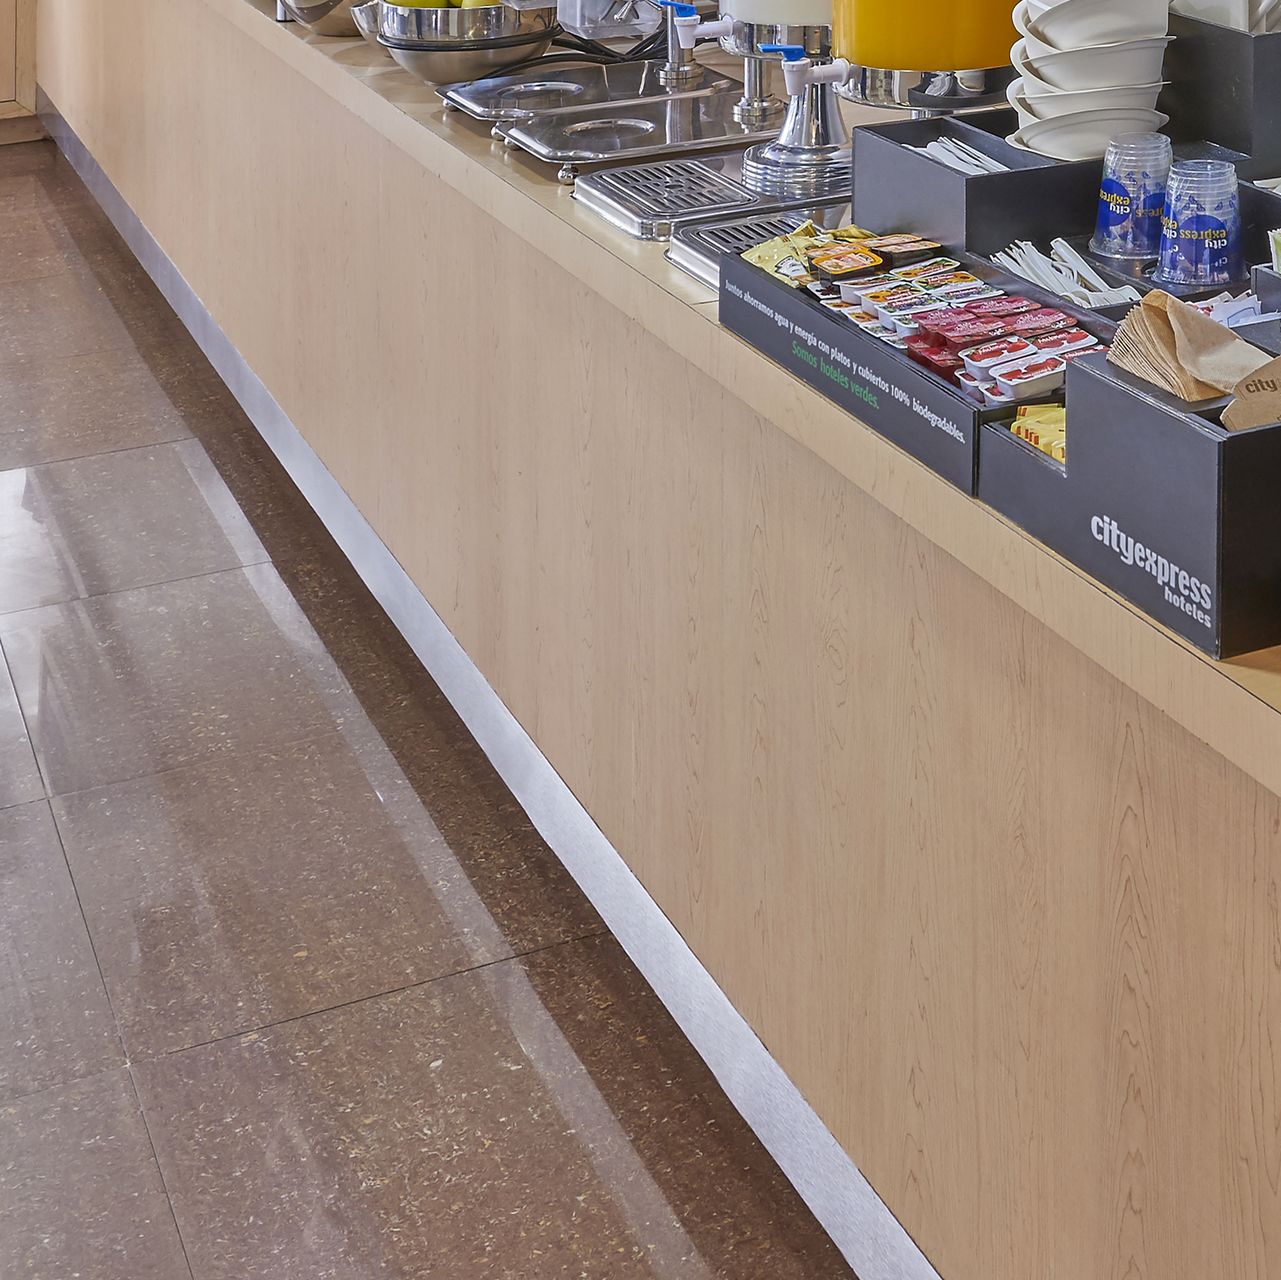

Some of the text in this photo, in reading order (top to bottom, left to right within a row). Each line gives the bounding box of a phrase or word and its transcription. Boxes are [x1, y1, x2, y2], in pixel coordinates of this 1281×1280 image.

[1179, 228, 1227, 240] express
[724, 279, 743, 299] Juntos
[743, 290, 774, 319] ahorramos
[774, 311, 789, 328] agua
[789, 321, 795, 334] y
[818, 340, 830, 354] con
[830, 347, 851, 368] platos
[852, 362, 857, 375] y
[858, 364, 889, 394] cubiertos
[890, 384, 910, 407] 100%
[912, 397, 966, 444] biodegradables.
[791, 340, 880, 410] Somos hoteles verdes.
[1164, 585, 1213, 629] hoteles
